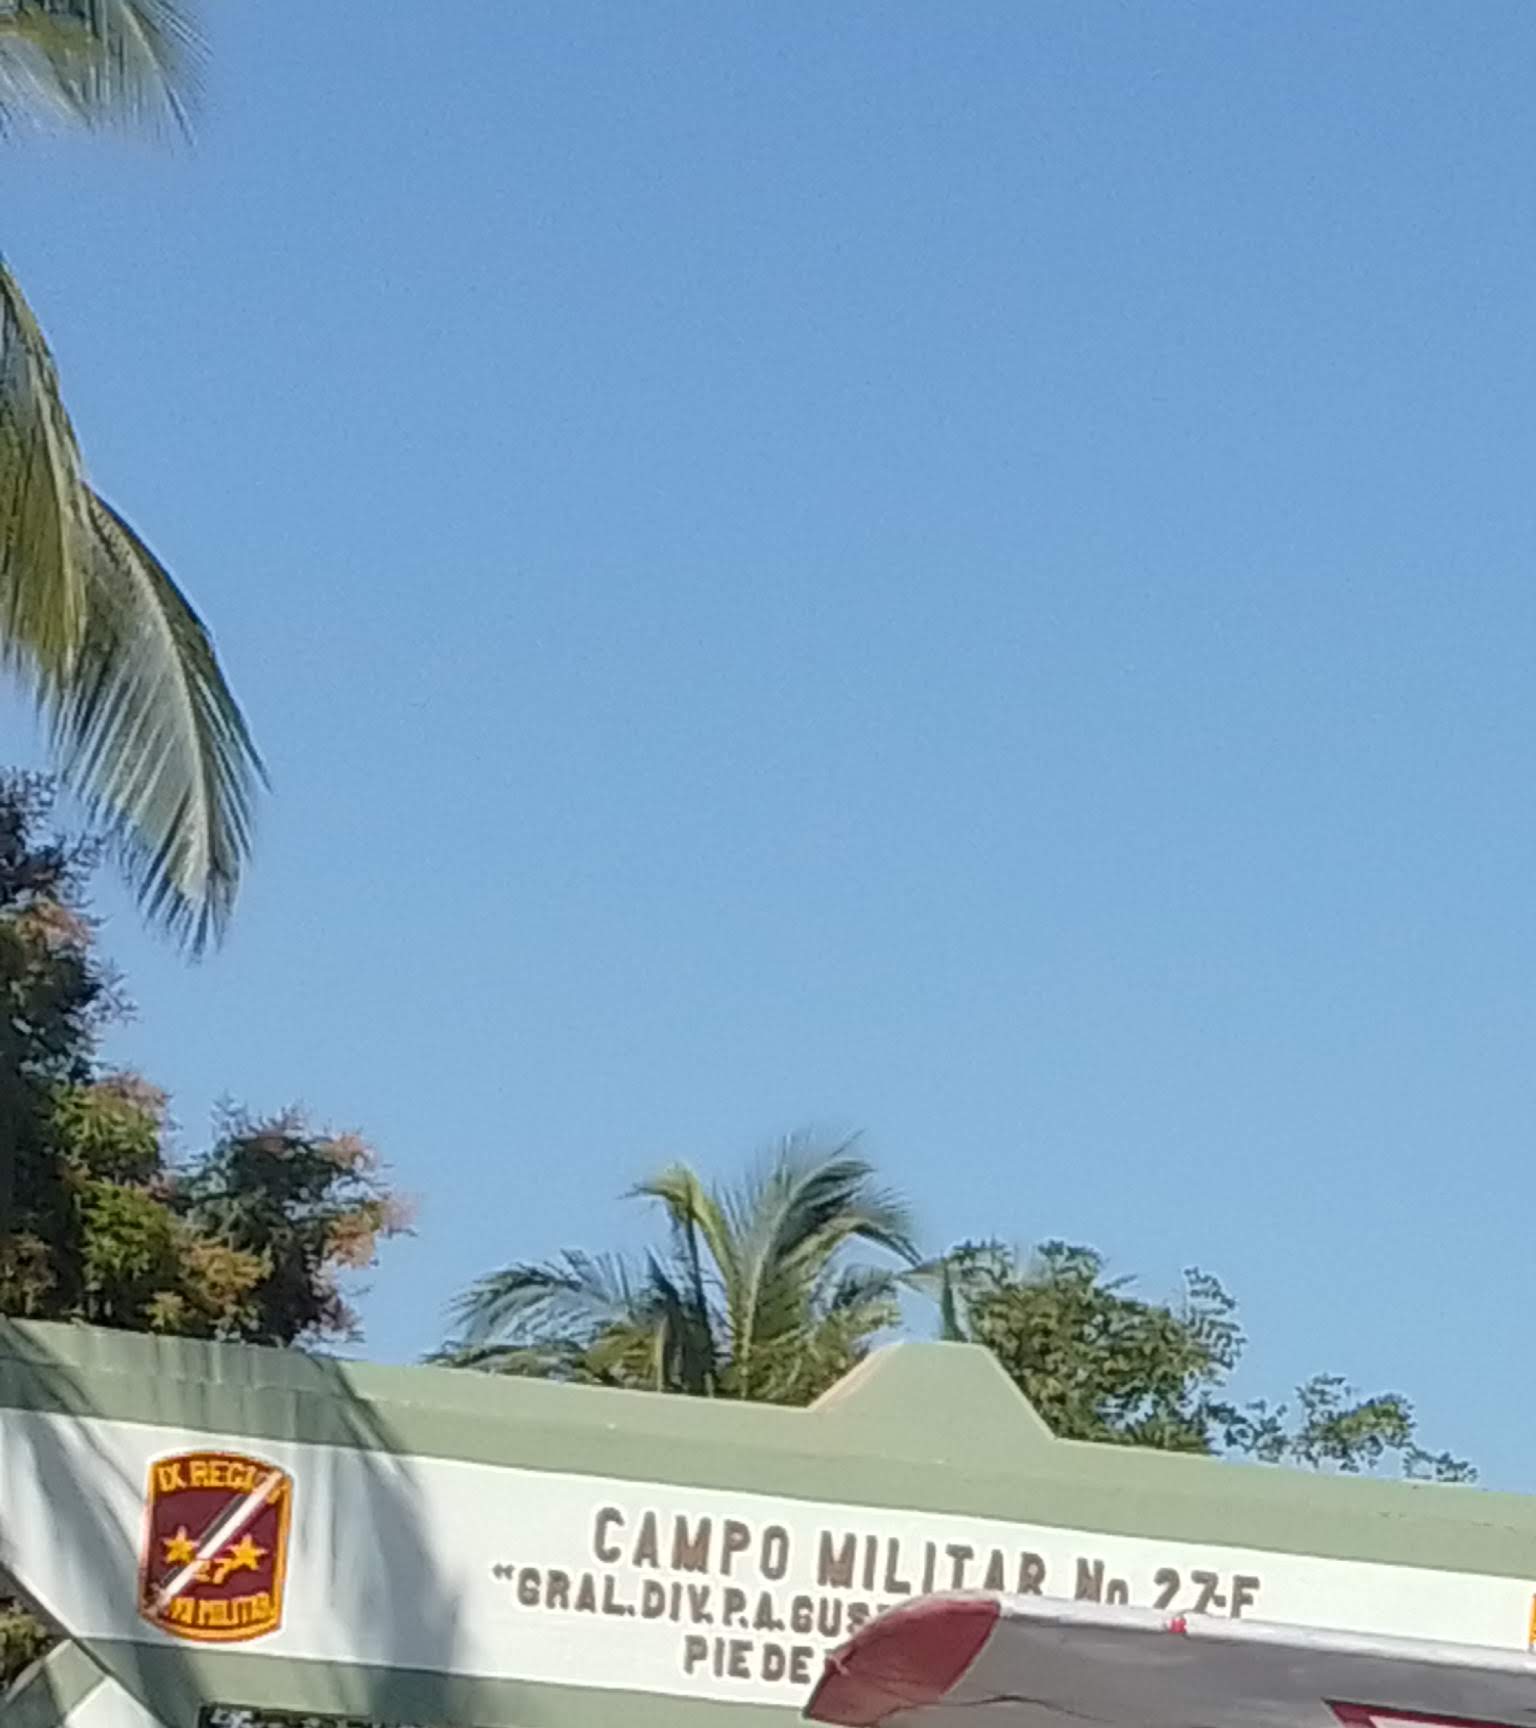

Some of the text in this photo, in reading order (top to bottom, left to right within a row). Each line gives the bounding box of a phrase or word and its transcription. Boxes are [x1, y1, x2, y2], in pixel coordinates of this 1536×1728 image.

[593, 1507, 790, 1581] CAMPO
[816, 1530, 1047, 1596] MILITAR
[1153, 1566, 1261, 1619] 27-F
[683, 1635, 814, 1684] PIE DE
